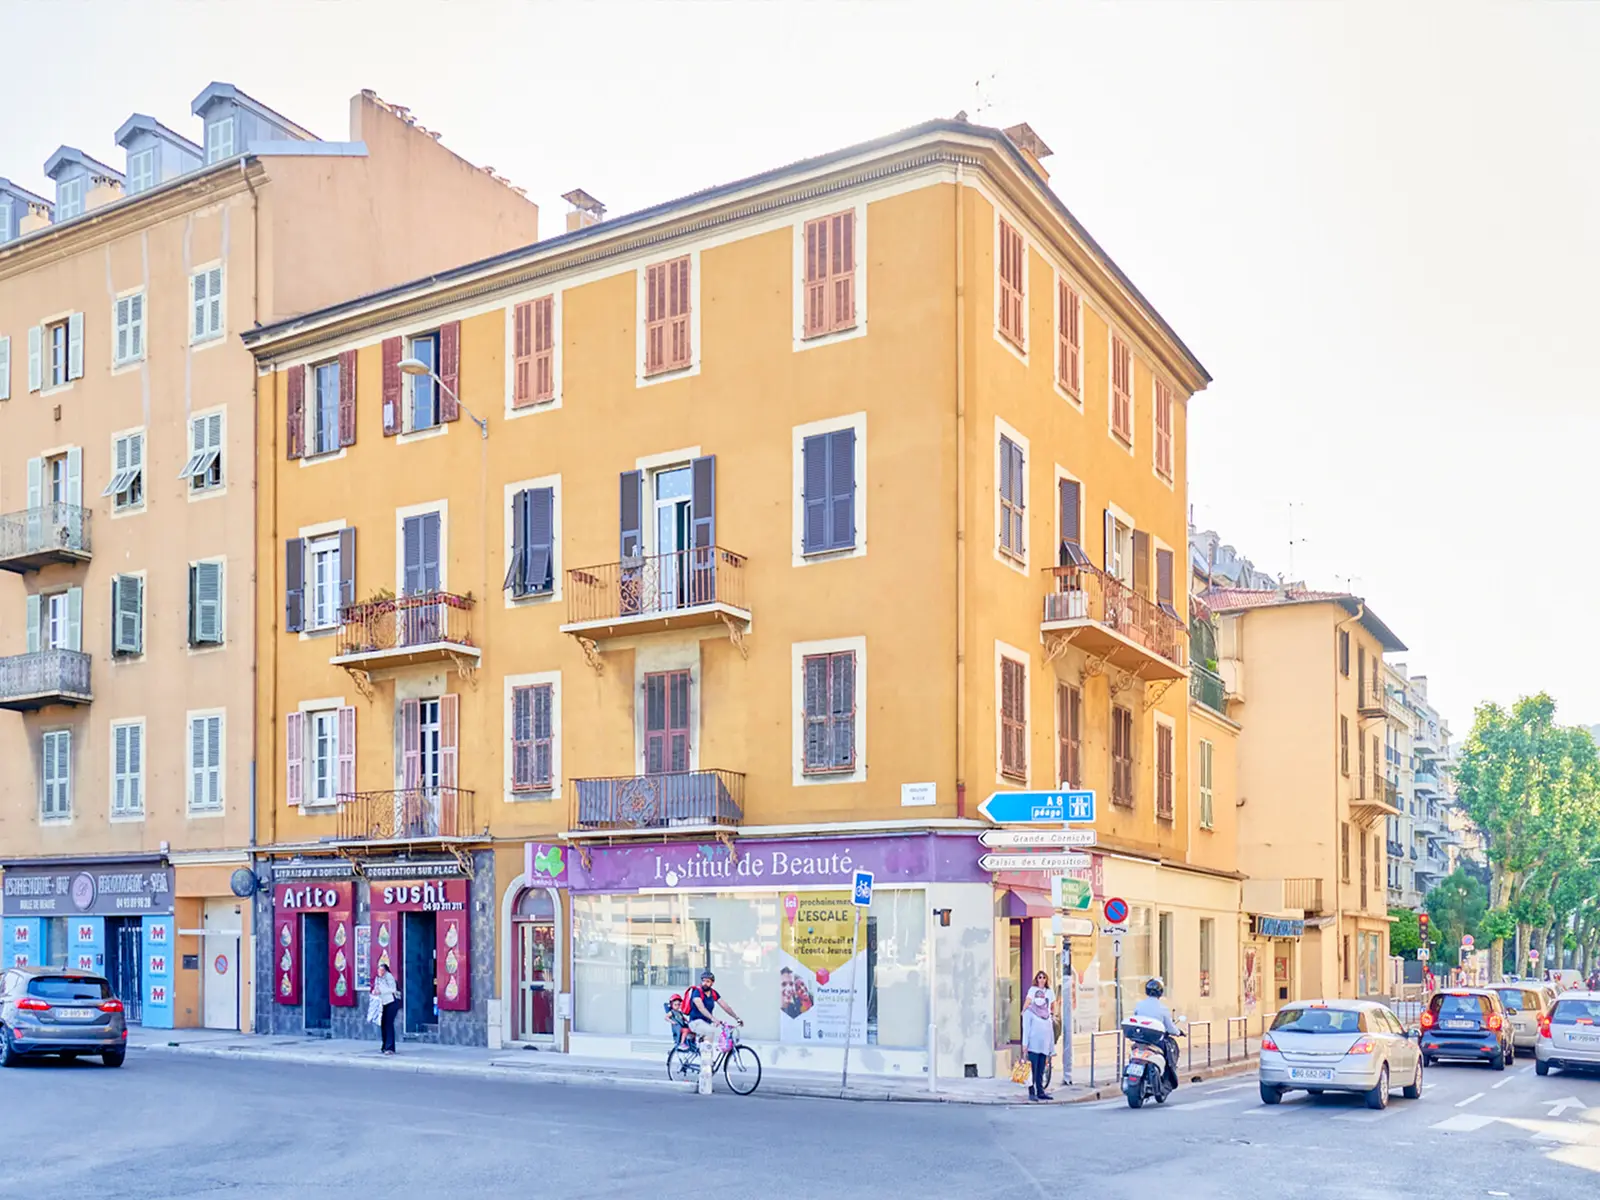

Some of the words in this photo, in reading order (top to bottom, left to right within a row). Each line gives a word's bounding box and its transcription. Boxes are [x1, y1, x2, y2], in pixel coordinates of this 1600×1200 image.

[1046, 796, 1053, 806] A
[1056, 796, 1063, 806] 8
[1012, 835, 1044, 843] Grande
[1050, 834, 1092, 842] Corniche
[738, 853, 764, 877] de
[771, 847, 852, 876] Beauté
[989, 858, 1016, 866] Palais
[1022, 858, 1036, 866] des
[417, 866, 433, 875] SUR
[434, 865, 458, 875] PLACE
[283, 886, 337, 908] Arito
[383, 880, 446, 905] sushi
[798, 910, 848, 922] L'ESCALE
